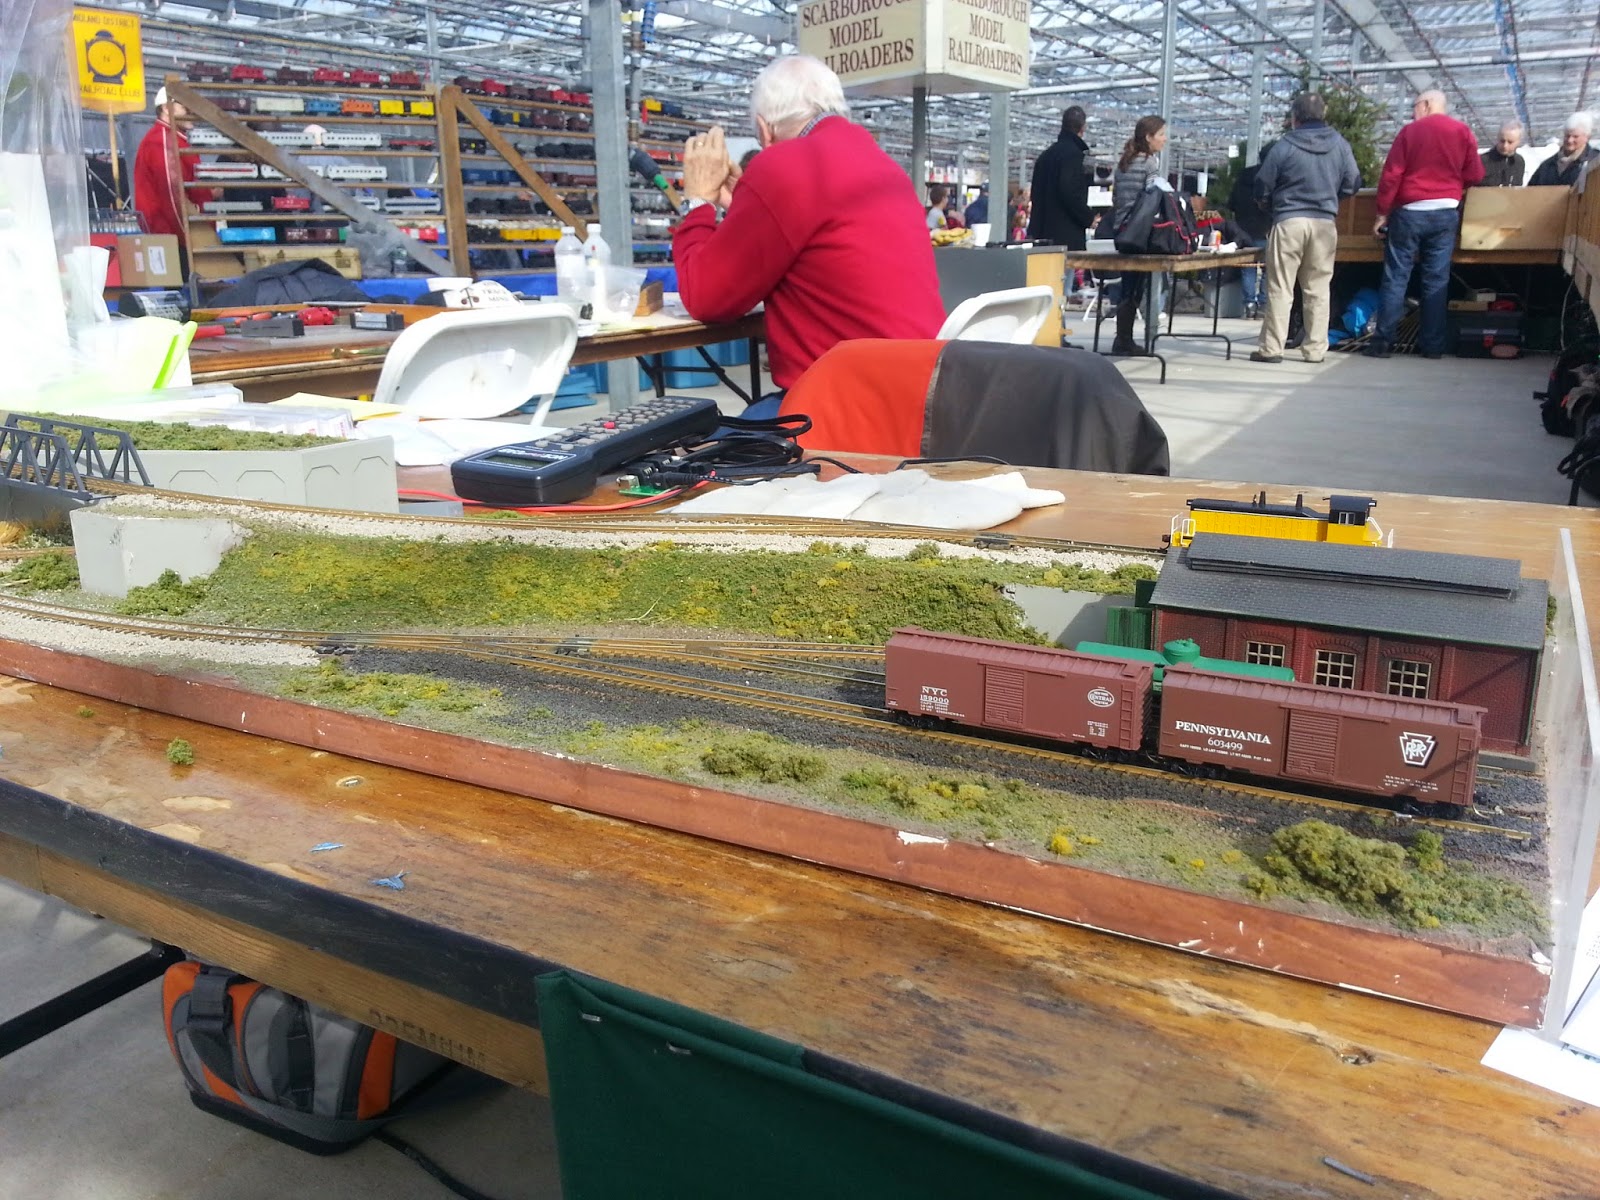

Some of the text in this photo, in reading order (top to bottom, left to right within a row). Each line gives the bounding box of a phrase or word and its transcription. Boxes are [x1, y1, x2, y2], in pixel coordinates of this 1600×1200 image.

[802, 0, 909, 28] SCARBOR
[953, 0, 1027, 23] OROUGH
[829, 16, 883, 49] MODEL
[969, 13, 1005, 44] MODEL
[825, 38, 914, 75] ILROADERS
[948, 37, 1023, 75] RAILROADERS
[921, 686, 948, 697] NYC
[1175, 720, 1272, 745] PENNSYLVANIA
[1207, 737, 1243, 751] 603499
